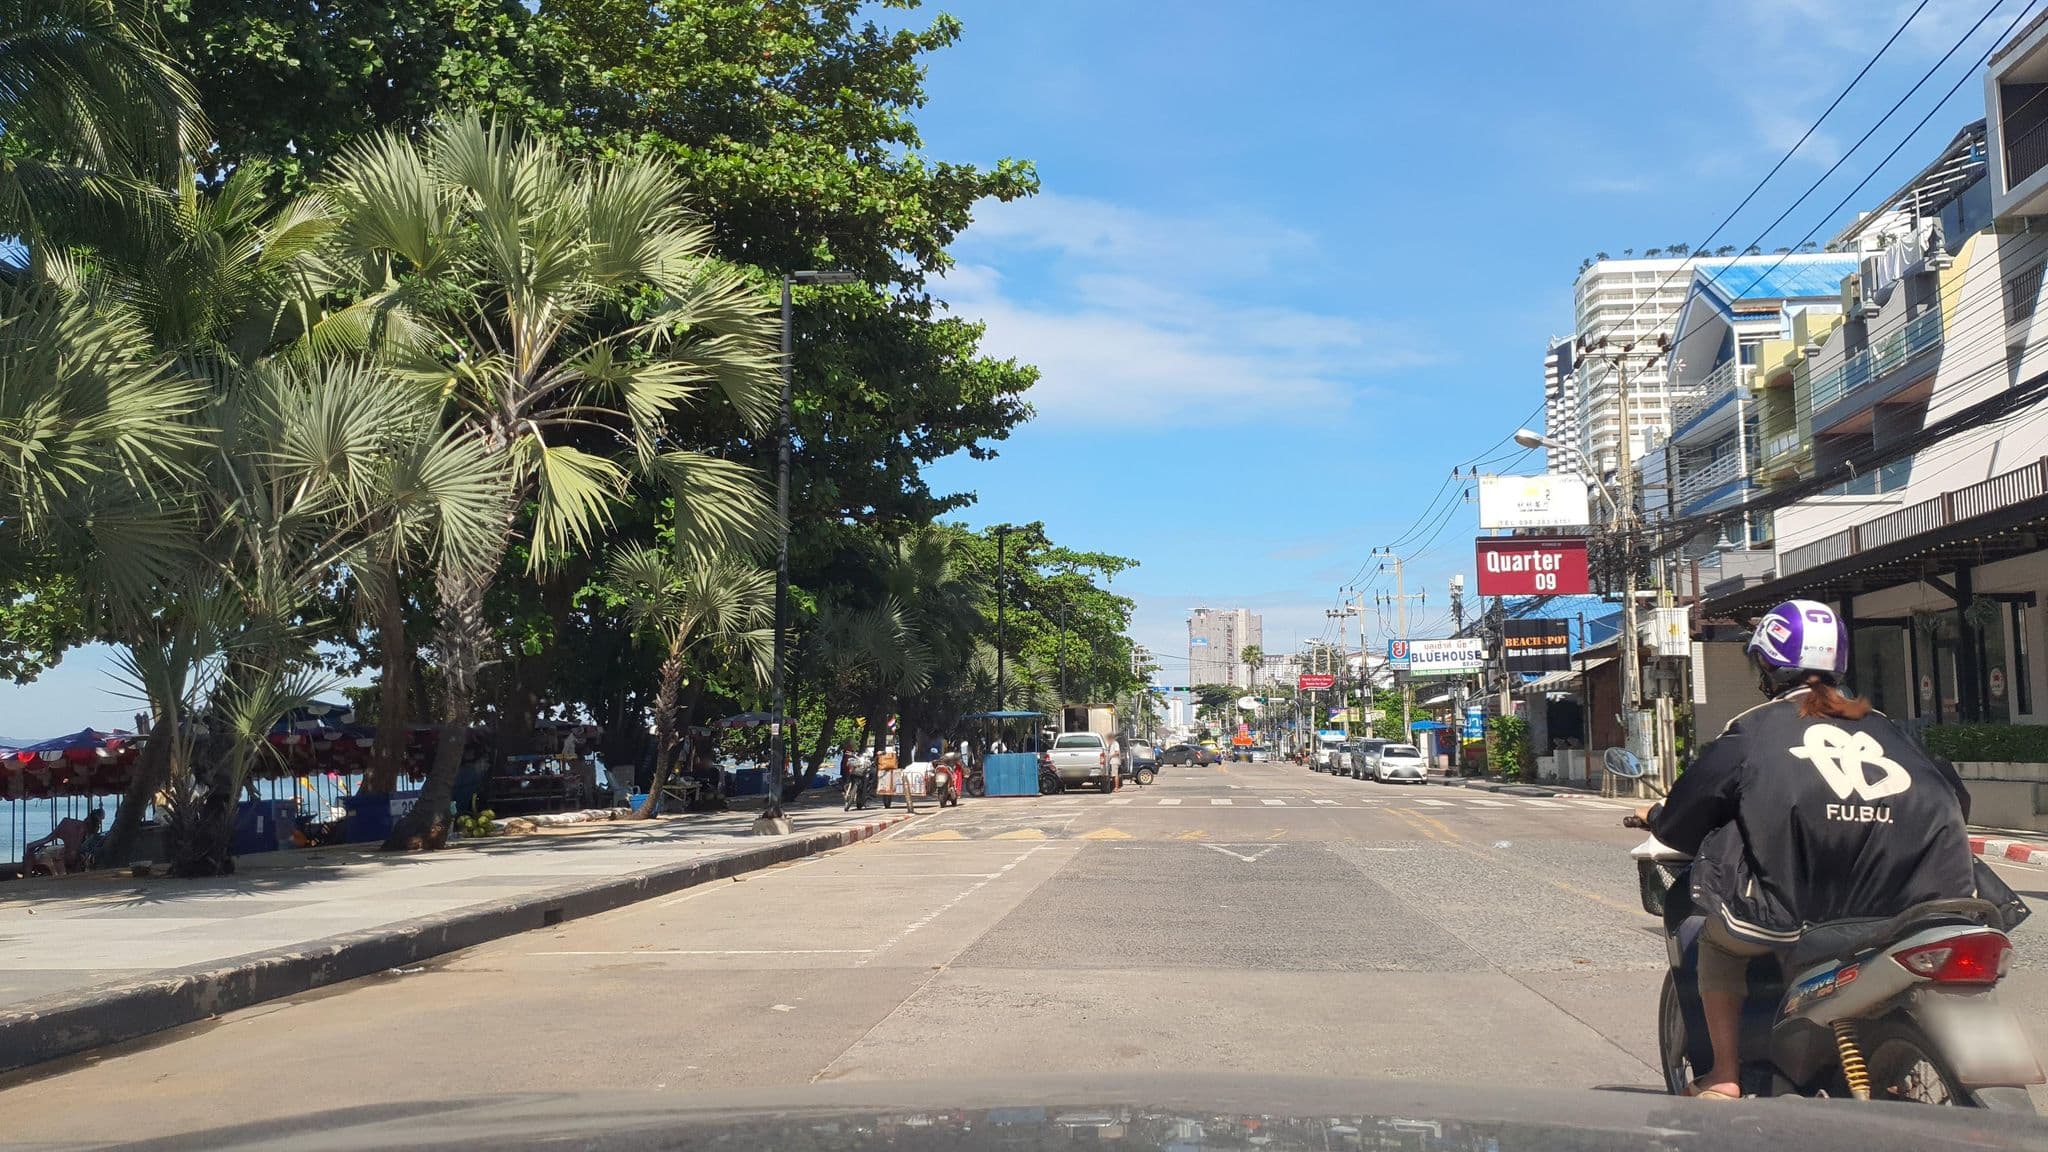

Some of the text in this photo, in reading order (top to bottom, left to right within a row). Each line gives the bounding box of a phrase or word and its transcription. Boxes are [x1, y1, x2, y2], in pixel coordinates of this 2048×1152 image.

[1487, 550, 1563, 573] Quarter
[1535, 573, 1557, 590] 09
[1411, 650, 1482, 663] BLUEHOUSE
